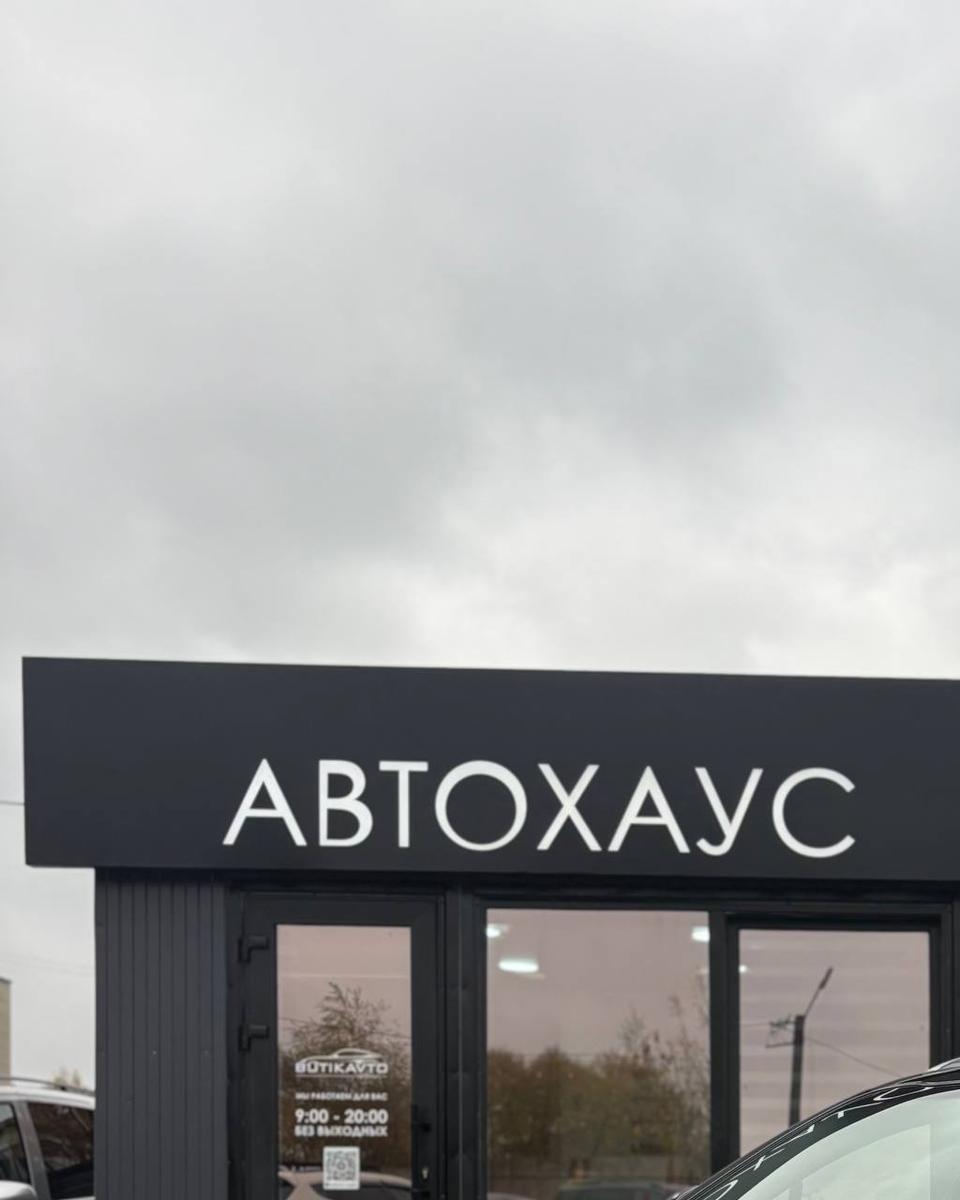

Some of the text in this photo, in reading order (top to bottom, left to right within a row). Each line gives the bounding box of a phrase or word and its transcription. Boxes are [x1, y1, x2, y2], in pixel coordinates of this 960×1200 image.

[223, 759, 854, 857] АВТОХАУС
[295, 1061, 389, 1074] BUTIKAVTO
[295, 1108, 329, 1124] 9:00
[344, 1108, 389, 1124] 20:00
[317, 1125, 388, 1138] ВЫХОДНЫХ
